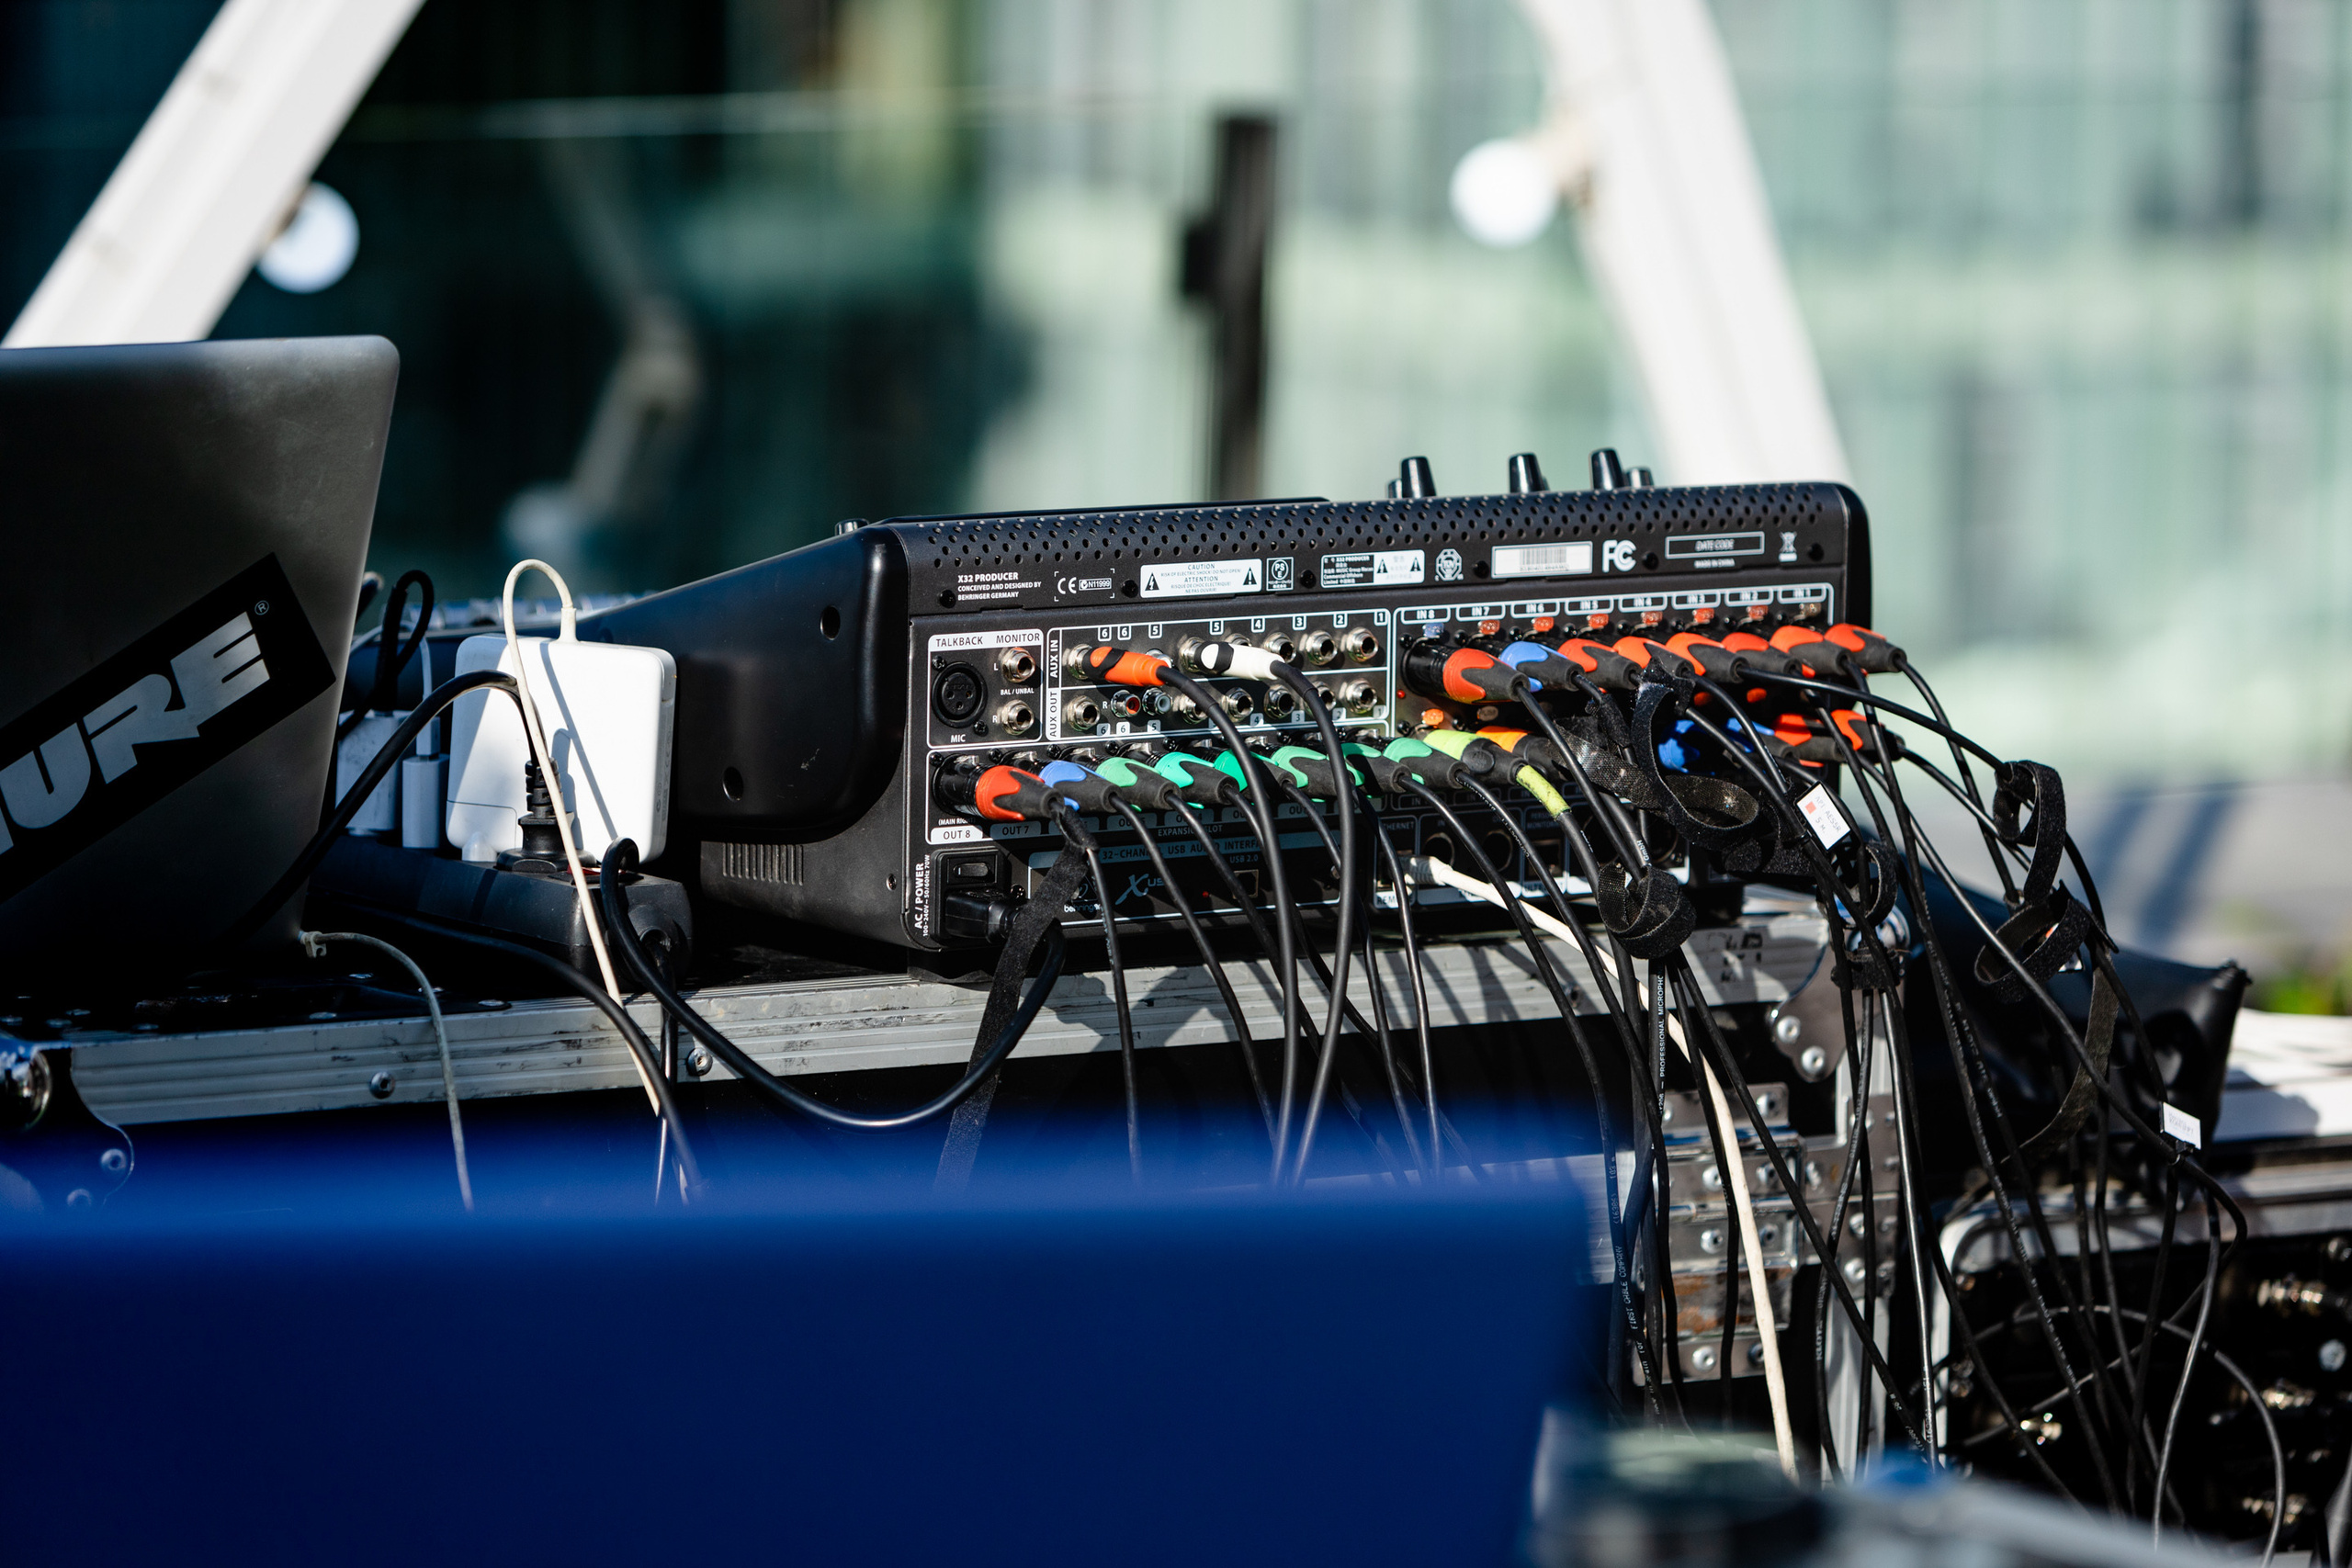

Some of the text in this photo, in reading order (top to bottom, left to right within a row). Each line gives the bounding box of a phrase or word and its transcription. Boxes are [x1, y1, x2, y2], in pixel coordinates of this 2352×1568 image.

[957, 572, 1019, 583] X32 PRODUCER
[957, 584, 990, 592] CONCEIVED
[957, 591, 1019, 601] BEHRINGER GERMANY
[1526, 604, 1544, 613] IN 6
[1580, 601, 1590, 610] IN
[1417, 610, 1435, 619] IN 8
[1472, 606, 1490, 615] IN 7
[1296, 617, 1303, 626] 3
[1337, 615, 1343, 624] 2
[1378, 612, 1384, 622] 1
[1214, 622, 1220, 631] 5
[1254, 619, 1261, 629] 4
[1102, 628, 1108, 638] 6
[1121, 626, 1127, 637] 6
[1152, 626, 1159, 635] 5
[936, 637, 983, 647] TALKBACK
[996, 633, 1040, 643] MONITOR
[1050, 639, 1058, 678] AUX IN
[993, 662, 999, 671] L
[1015, 687, 1035, 695] UNBAL
[1102, 701, 1108, 709] R
[992, 715, 998, 723] R
[1254, 716, 1260, 725] 4
[1295, 714, 1301, 722] 3
[1049, 716, 1057, 738] AUX
[1100, 727, 1106, 735] 6
[1120, 725, 1126, 734] 6
[1151, 723, 1157, 731] 5
[0, 612, 270, 854] URE
[950, 734, 966, 743] MIC
[943, 829, 971, 840] OUT 8
[1002, 825, 1029, 836] OUT 7
[1168, 845, 1185, 854] USB
[1636, 840, 1650, 861] GmbH
[1229, 854, 1259, 863] USB 2.0
[915, 863, 924, 903] POWER
[914, 914, 923, 930] AC
[1615, 1246, 1626, 1278] COMPANY
[1621, 1280, 1631, 1304] CABLE
[1626, 1307, 1638, 1330] FIRST
